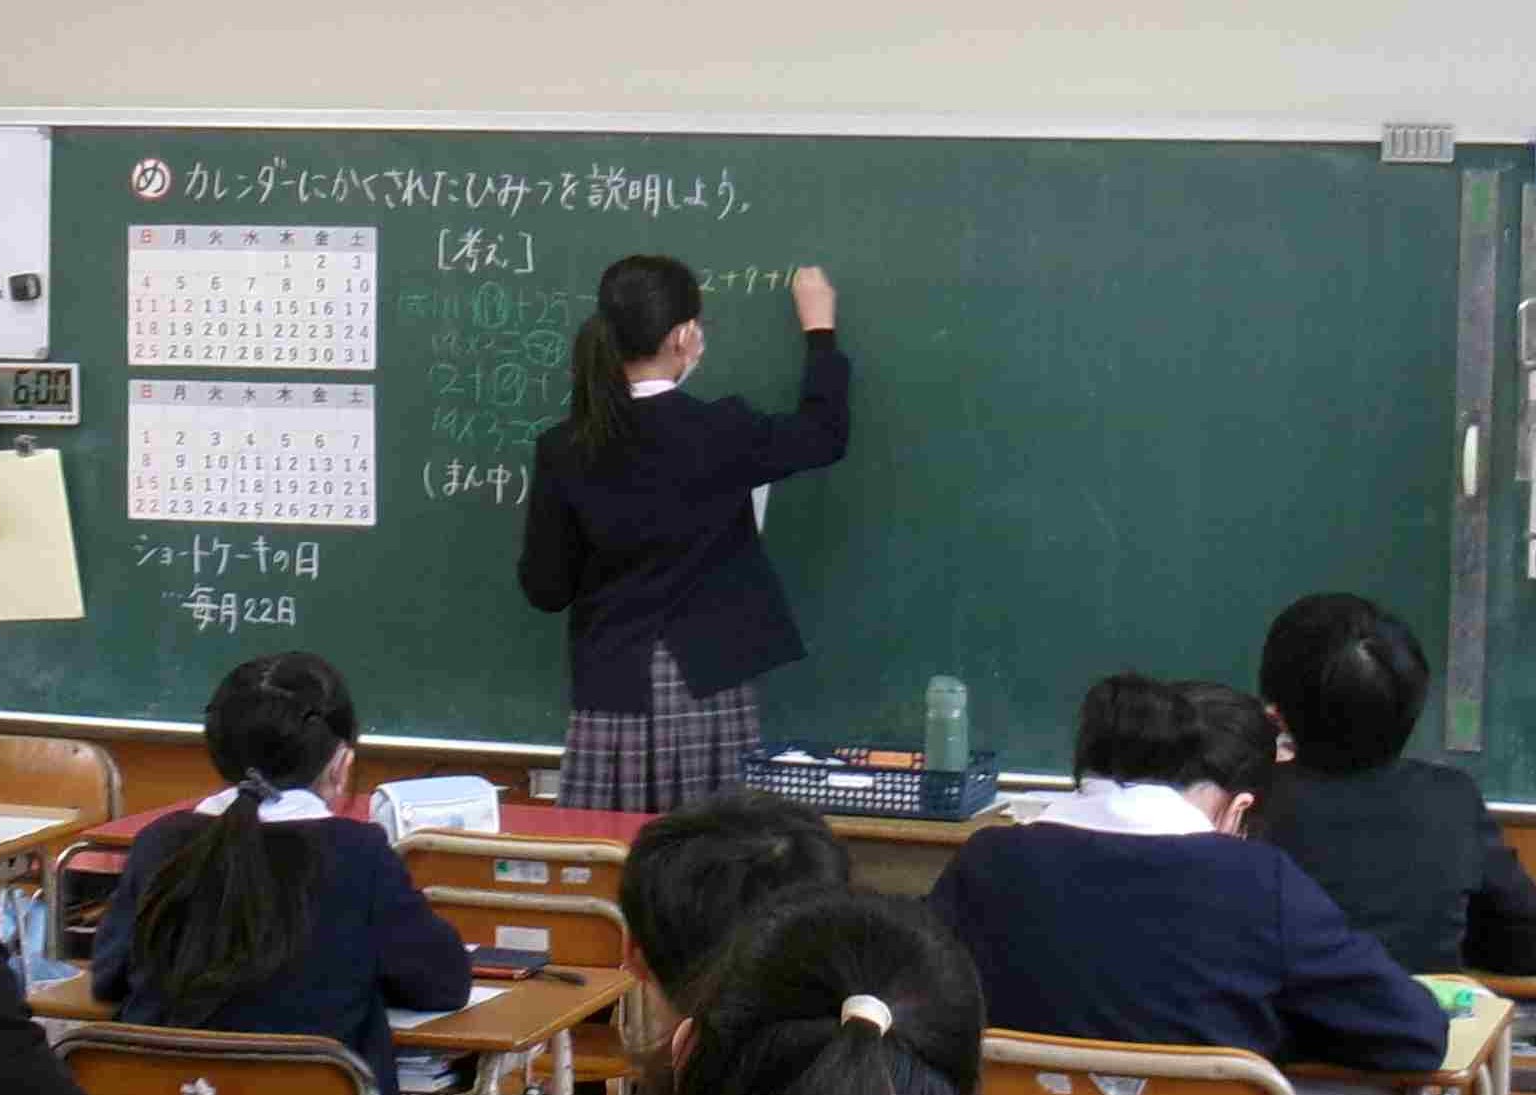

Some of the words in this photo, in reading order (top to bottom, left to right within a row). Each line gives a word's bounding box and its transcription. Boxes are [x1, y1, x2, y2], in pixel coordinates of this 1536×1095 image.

[134, 161, 166, 195] め
[140, 228, 153, 244] 日
[173, 228, 187, 246] 月
[207, 229, 223, 246] 火
[243, 229, 259, 245] 水
[279, 229, 294, 244] 木
[315, 230, 329, 247] 金
[350, 230, 366, 247] 土
[140, 383, 153, 399] 日
[173, 384, 187, 401] 月
[207, 385, 224, 401] 火
[241, 387, 256, 402] 水
[277, 387, 293, 402] 木
[311, 386, 328, 403] 金
[349, 387, 364, 404] 土
[128, 534, 320, 581] ショートケーキの日
